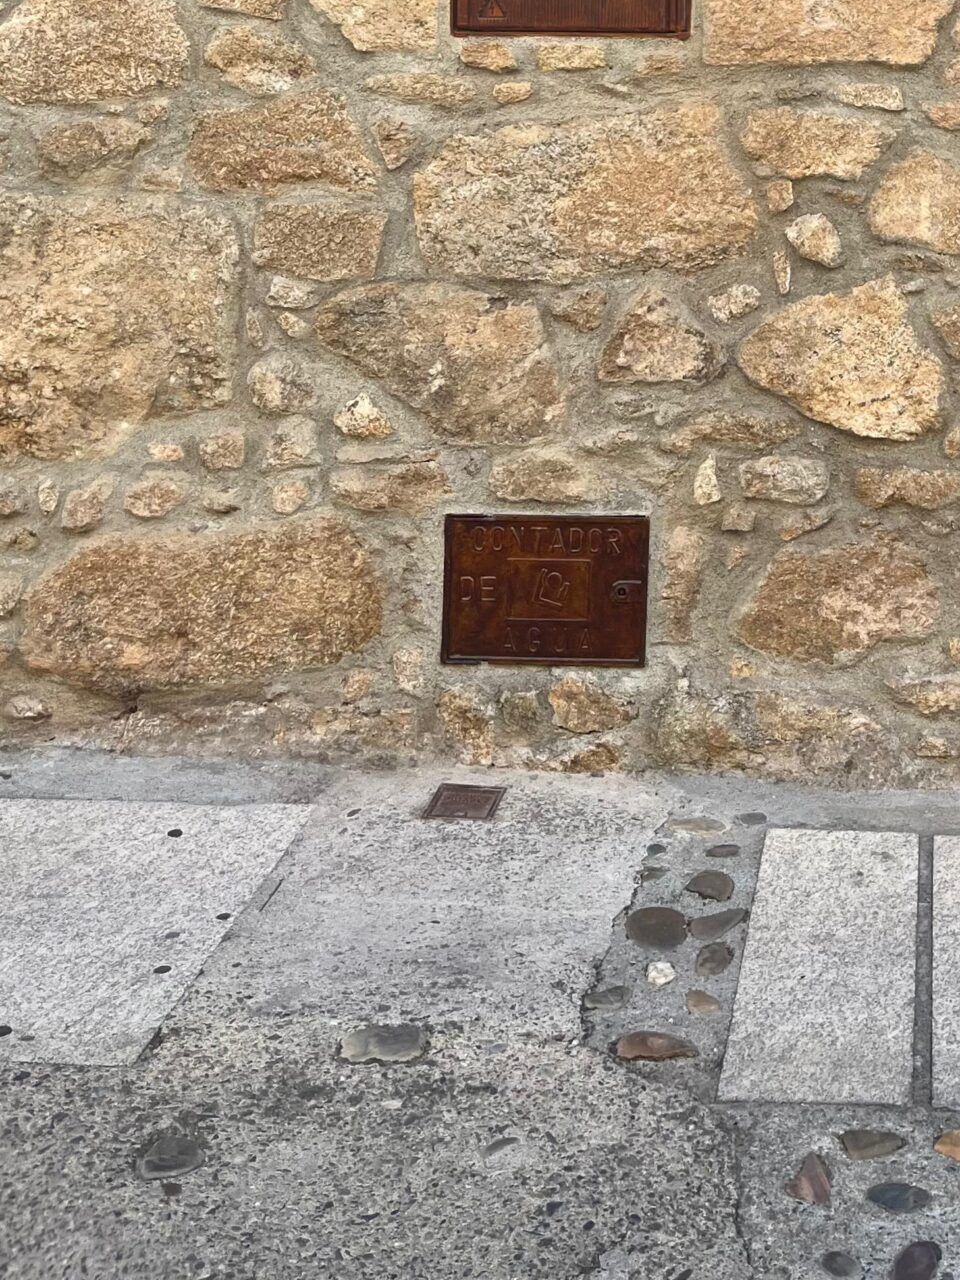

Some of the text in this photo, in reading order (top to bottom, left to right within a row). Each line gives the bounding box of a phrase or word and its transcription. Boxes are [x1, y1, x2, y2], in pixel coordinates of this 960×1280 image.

[472, 525, 623, 554] CONTADOR
[459, 575, 497, 601] DE
[502, 625, 594, 654] AGUA
